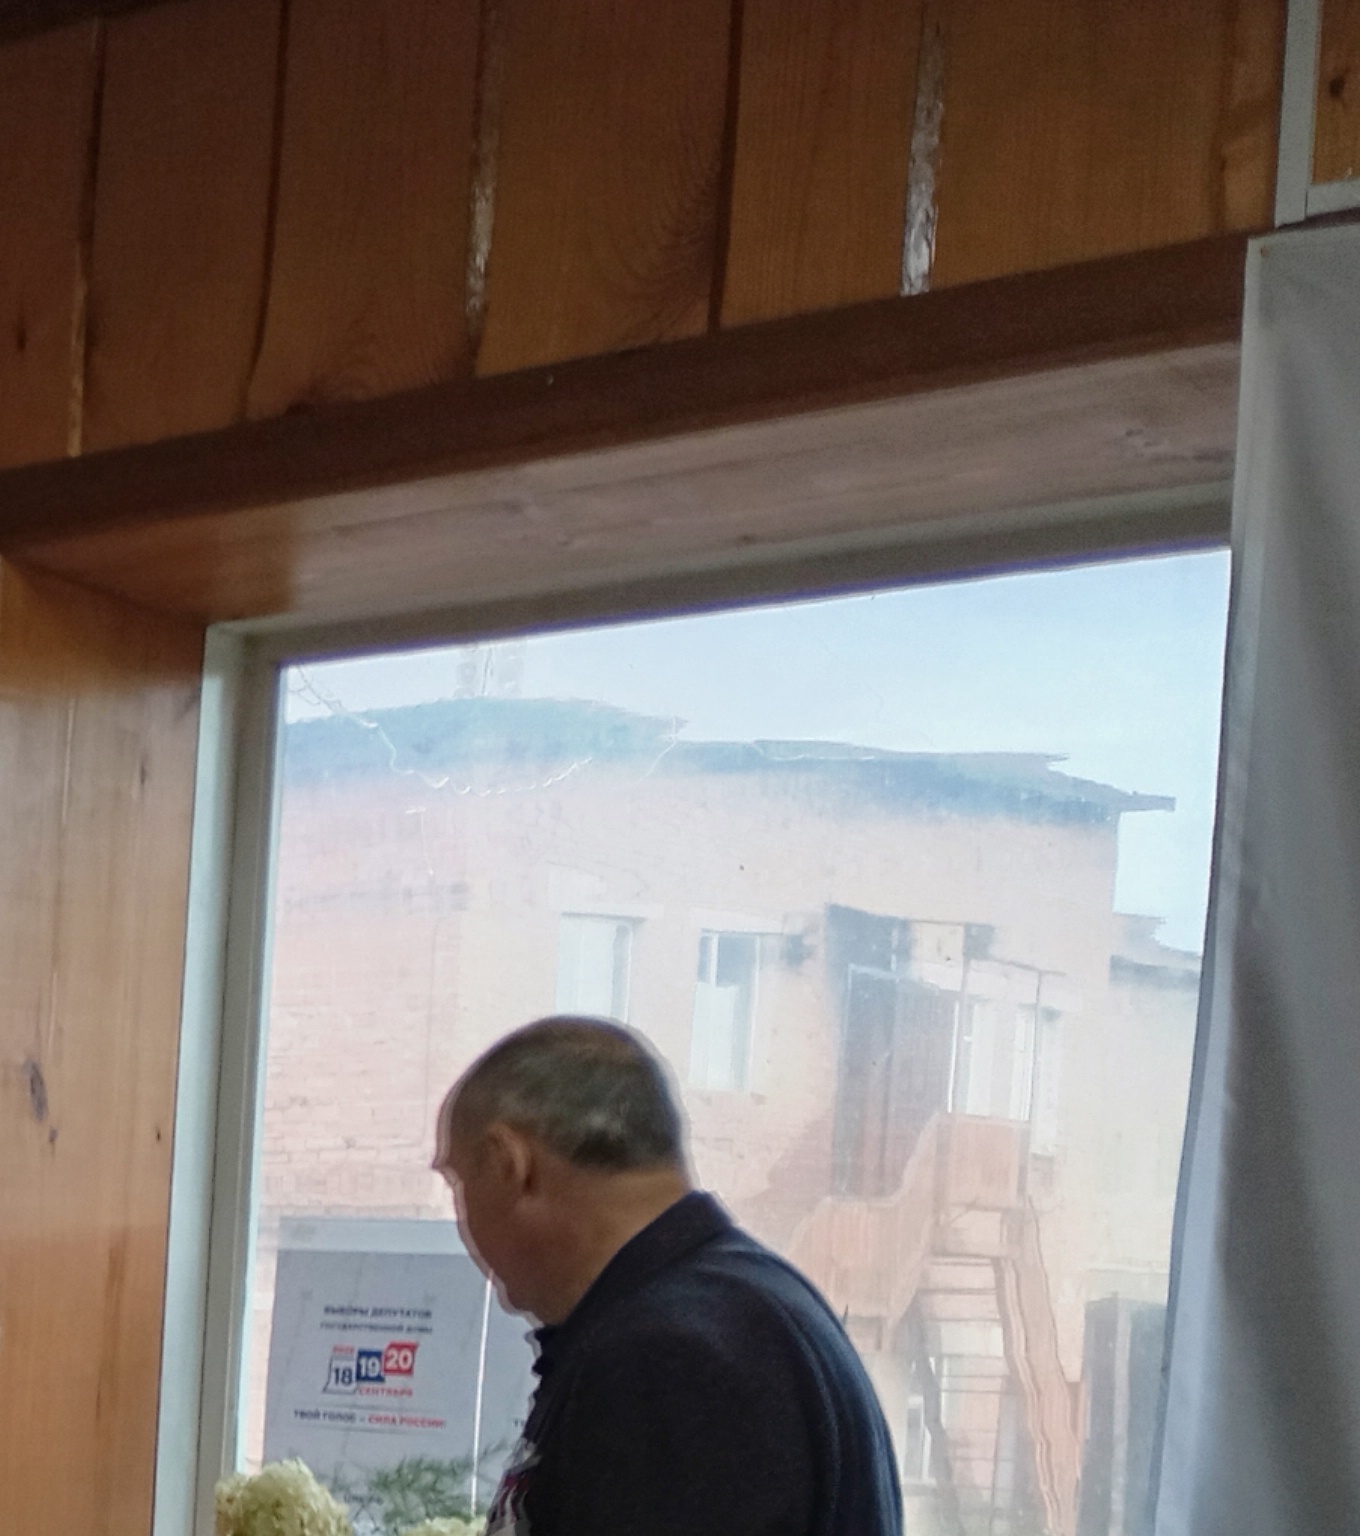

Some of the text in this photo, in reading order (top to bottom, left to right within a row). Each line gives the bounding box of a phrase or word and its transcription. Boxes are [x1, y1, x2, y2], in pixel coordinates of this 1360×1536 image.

[334, 1348, 413, 1386] 18 19 20
